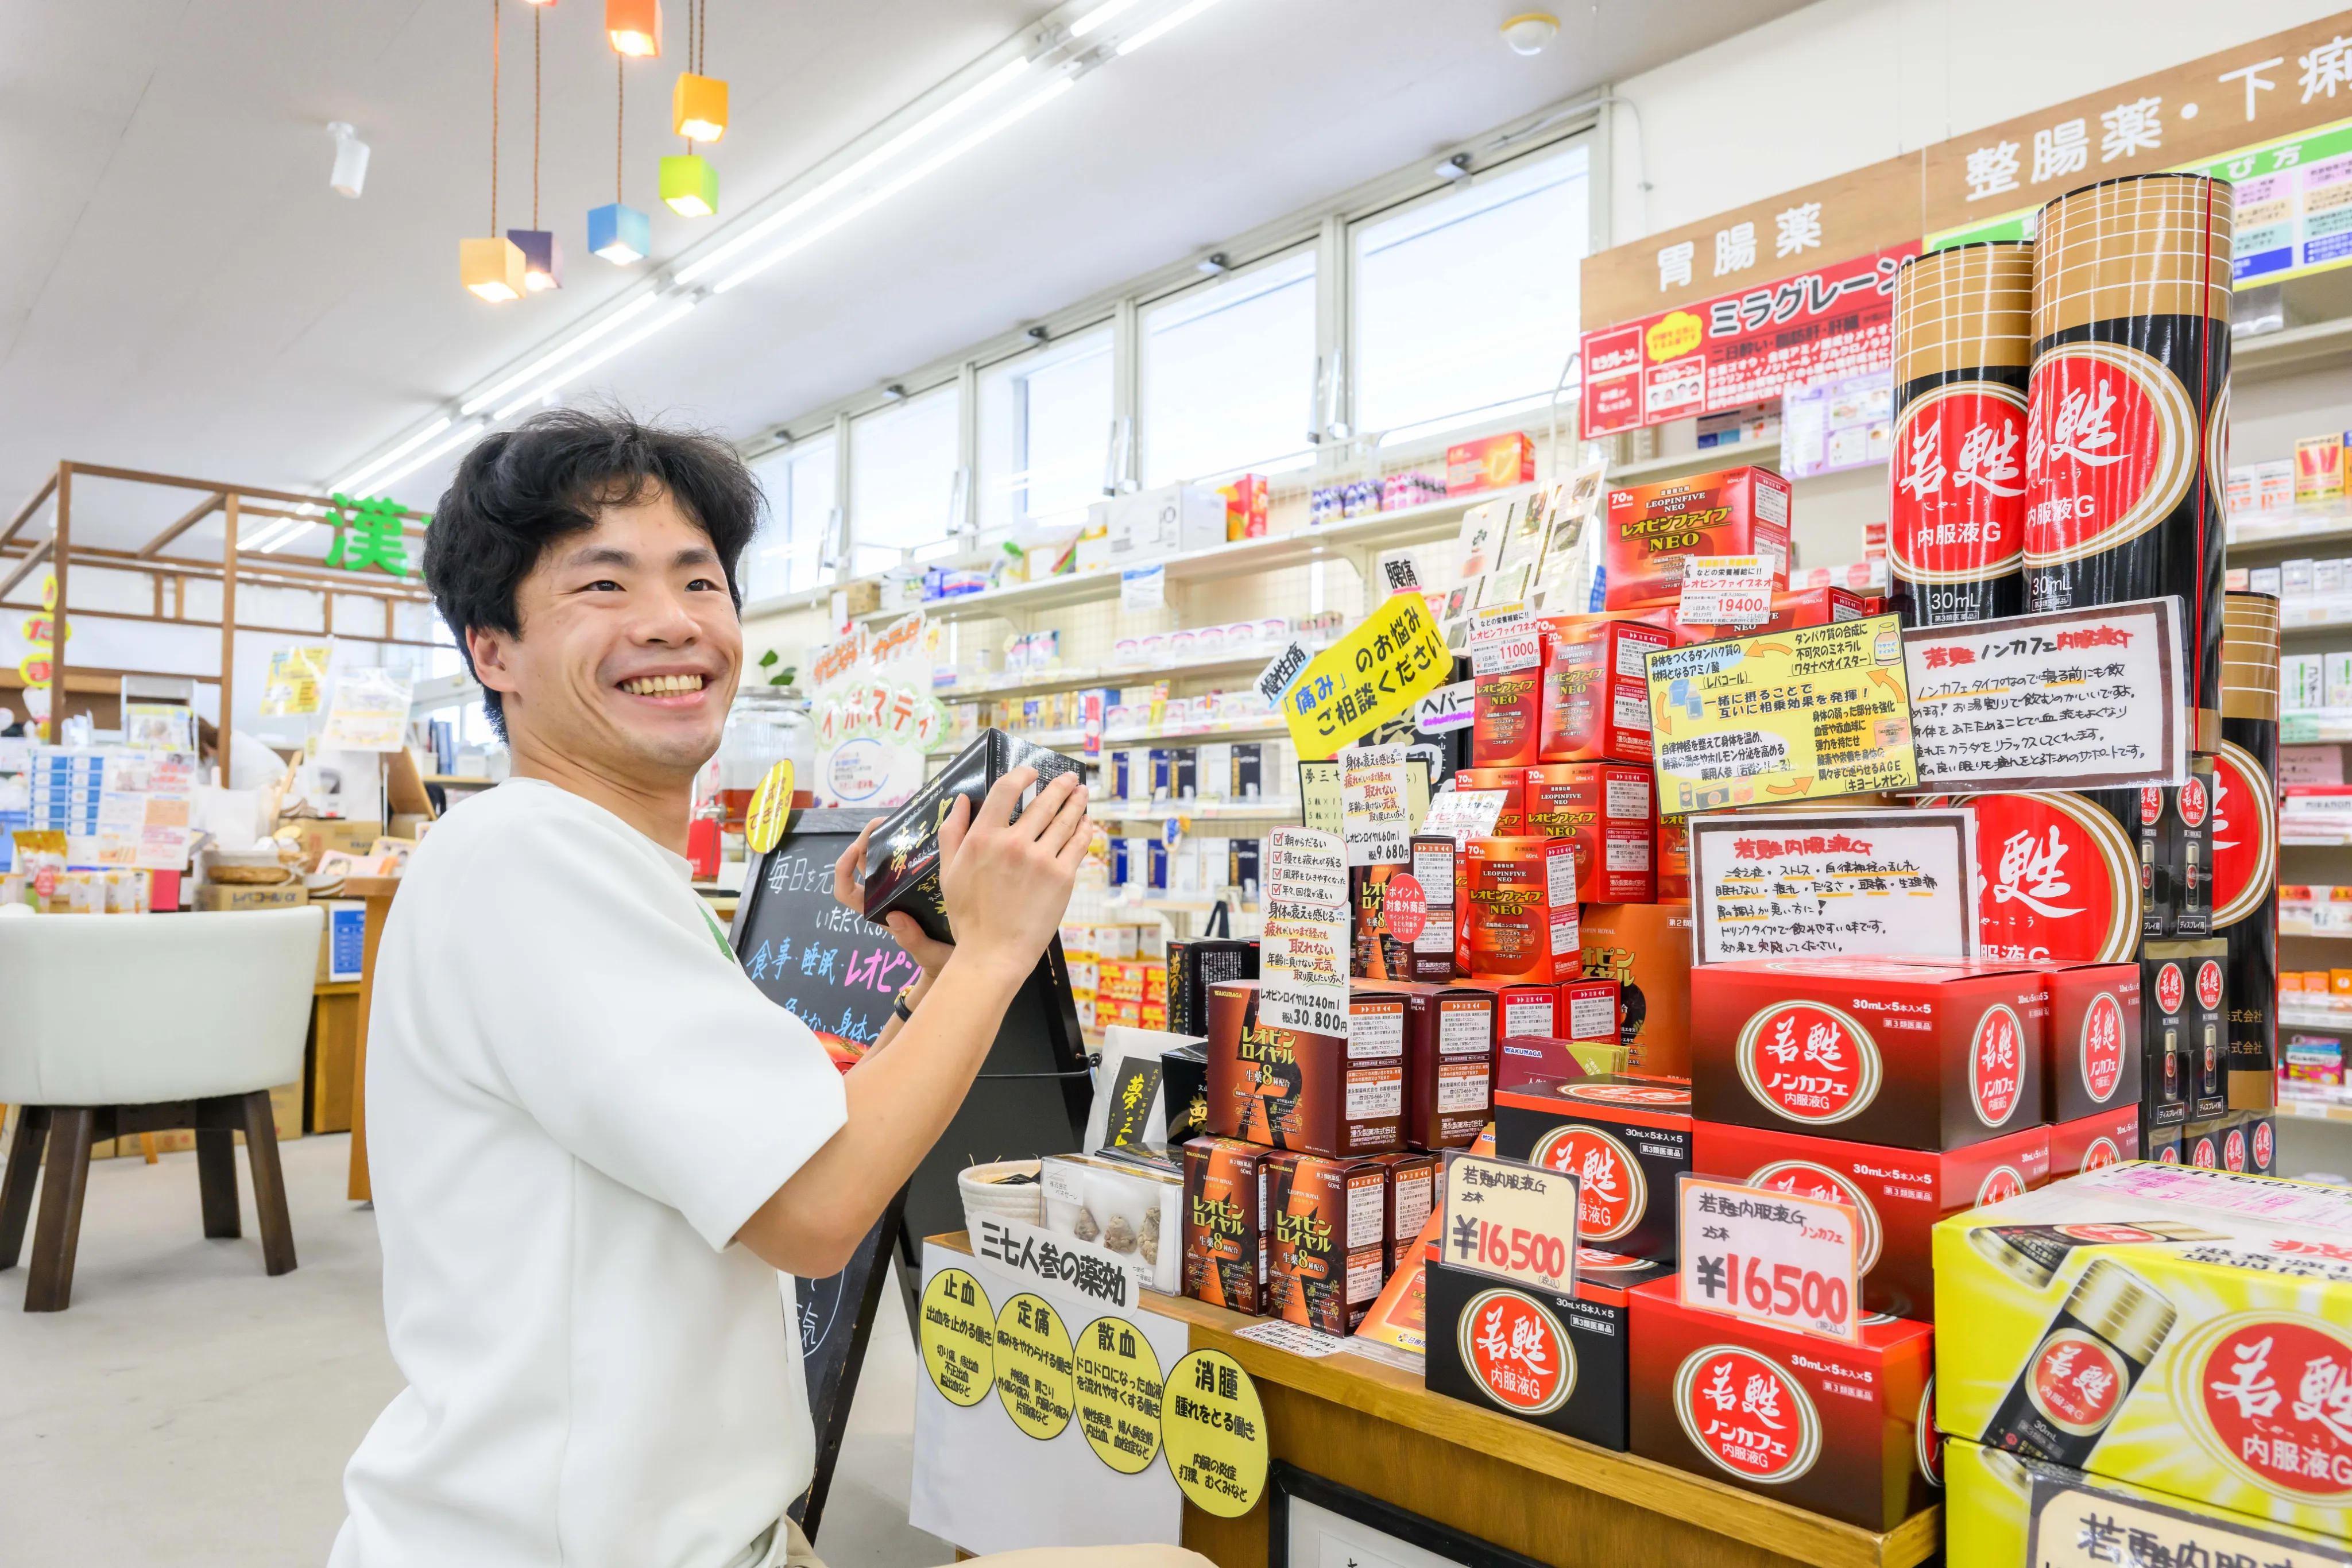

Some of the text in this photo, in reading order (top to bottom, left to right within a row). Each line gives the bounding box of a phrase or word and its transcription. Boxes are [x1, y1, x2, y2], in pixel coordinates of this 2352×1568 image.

[1657, 202, 1822, 292] 胃腸薬
[1612, 492, 1634, 503] 70th
[1645, 492, 1705, 509] LEOPINFIVE
[1664, 503, 1685, 513] NEO
[1620, 507, 1732, 537] レオピンファイブ
[325, 492, 426, 576] 漢
[1649, 532, 1700, 552] NEO
[1916, 520, 2001, 548] 内服液G
[1386, 559, 1418, 591] 腰痛
[2032, 571, 2072, 596] 30mL
[1718, 598, 1769, 613] 19400円
[1931, 591, 1980, 611] 30mL
[1796, 622, 1868, 645] タンパク質の合成に
[1500, 641, 1539, 659] 11000円
[1558, 651, 1593, 660] LEOPINFIVE
[1651, 642, 1741, 668] 身体をつくるタンパク質の
[1796, 642, 1861, 660] 不可欠のミネラル
[1260, 640, 1306, 702] 慢性痛
[1545, 668, 1605, 684] レオピンファイブ
[1652, 661, 1720, 683] 材料となるアミノ酸
[1317, 630, 1442, 736] ご相談ください
[1476, 680, 1535, 694] レオピンファイブ
[1560, 684, 1587, 696] NEO
[1491, 695, 1518, 706] NEO
[1705, 683, 1813, 706] 一緒に摂ることで
[1812, 702, 1895, 722] 身体の弱った部分を強化
[1814, 720, 1867, 737] 血管や赤血球に
[1528, 771, 1545, 780] 70th
[1364, 784, 1396, 799] 取れない
[1527, 812, 1597, 823] レオピンファイブ
[1284, 835, 1327, 849] 朝からだるい
[1346, 831, 1399, 843] レオピンロイヤル60ml
[1283, 853, 1343, 869] 寝ても疲れが残る
[1468, 846, 1485, 855] 70th
[1283, 870, 1347, 886] 風邪をひきやすくなった
[1389, 887, 1420, 899] ポイント
[1470, 890, 1543, 900] レオピンファイブ
[1386, 900, 1426, 914] 対象外商品
[1390, 913, 1421, 922] ポイントクーポン
[1490, 904, 1523, 915] NEO
[2179, 919, 2206, 932] ディスプレイ用
[1289, 938, 1334, 955] 取れない
[1581, 947, 1635, 966] オピン
[1214, 990, 1242, 998] WAKUNAGA
[1260, 989, 1341, 1011] レオピンロイヤル240ml
[1852, 998, 1932, 1015] 30mL×5本入×5
[1883, 1019, 1931, 1030] 第3類医薬品
[1242, 1026, 1297, 1048] レオピン
[1765, 1015, 1848, 1072] 若甦
[1242, 1043, 1296, 1064] ロイヤル
[1504, 1046, 1542, 1058] WAKUNAGA
[1245, 1064, 1291, 1089] 生薬8種配合
[2090, 1058, 2117, 1078] ノンカフェ
[1766, 1073, 1850, 1097] ノンカフェ
[1981, 1076, 2015, 1099] ノンカフェ
[1784, 1091, 1831, 1110] 内服液G
[2199, 1100, 2222, 1114] ディスプレイ用
[2158, 1107, 2183, 1121] ディスプレイ用
[1641, 1144, 1682, 1159] 第3類医薬品
[1316, 1172, 1341, 1183] 第2類医薬品
[1853, 1163, 1932, 1184] 30mL×5本入×5
[1287, 1188, 1320, 1201] LEOPIN ROYAL
[1328, 1182, 1341, 1190] 60mL
[1193, 1195, 1245, 1221] レオピン
[1193, 1216, 1245, 1236] ロイヤル
[1276, 1209, 1332, 1236] レオピン
[1199, 1232, 1239, 1255] 生薬8種配合
[1276, 1229, 1332, 1253] ロイヤル
[1800, 1225, 1844, 1245] ノンカフェ
[1452, 1213, 1566, 1279] ¥16,500
[981, 1220, 1126, 1307] 三七人参の薬効
[1283, 1249, 1325, 1273] 生薬8種配合
[943, 1273, 975, 1307] 止血
[1696, 1252, 1848, 1326] ¥16,500
[1017, 1299, 1050, 1337] 定痛
[1556, 1298, 1615, 1319] 30mL×5本入×5
[926, 1304, 992, 1347] 出血を止める働き
[1572, 1316, 1613, 1334] 第3類医薬品
[1097, 1321, 1136, 1360] 散血
[1476, 1305, 1554, 1376] 若甦
[997, 1329, 1073, 1376] 痛みをやわらげる働き
[945, 1361, 969, 1384] 不正出血
[1076, 1356, 1163, 1401] ドロドロになった血液
[1791, 1354, 1873, 1383] 30mL×5本入×5
[1194, 1358, 1239, 1401] 消腫
[1491, 1368, 1541, 1400] 内服液G
[1076, 1375, 1161, 1420] を流れやすくする働き
[1702, 1361, 1788, 1430] 若甦
[1016, 1399, 1049, 1426] 片頭痛など
[1174, 1395, 1255, 1442] 腫れをとる働き
[1704, 1419, 1788, 1458] ノンカフェ
[1722, 1442, 1769, 1468] 内服液G
[2242, 1435, 2352, 1484] 内服液G
[1193, 1453, 1237, 1481] 内臓の炎症
